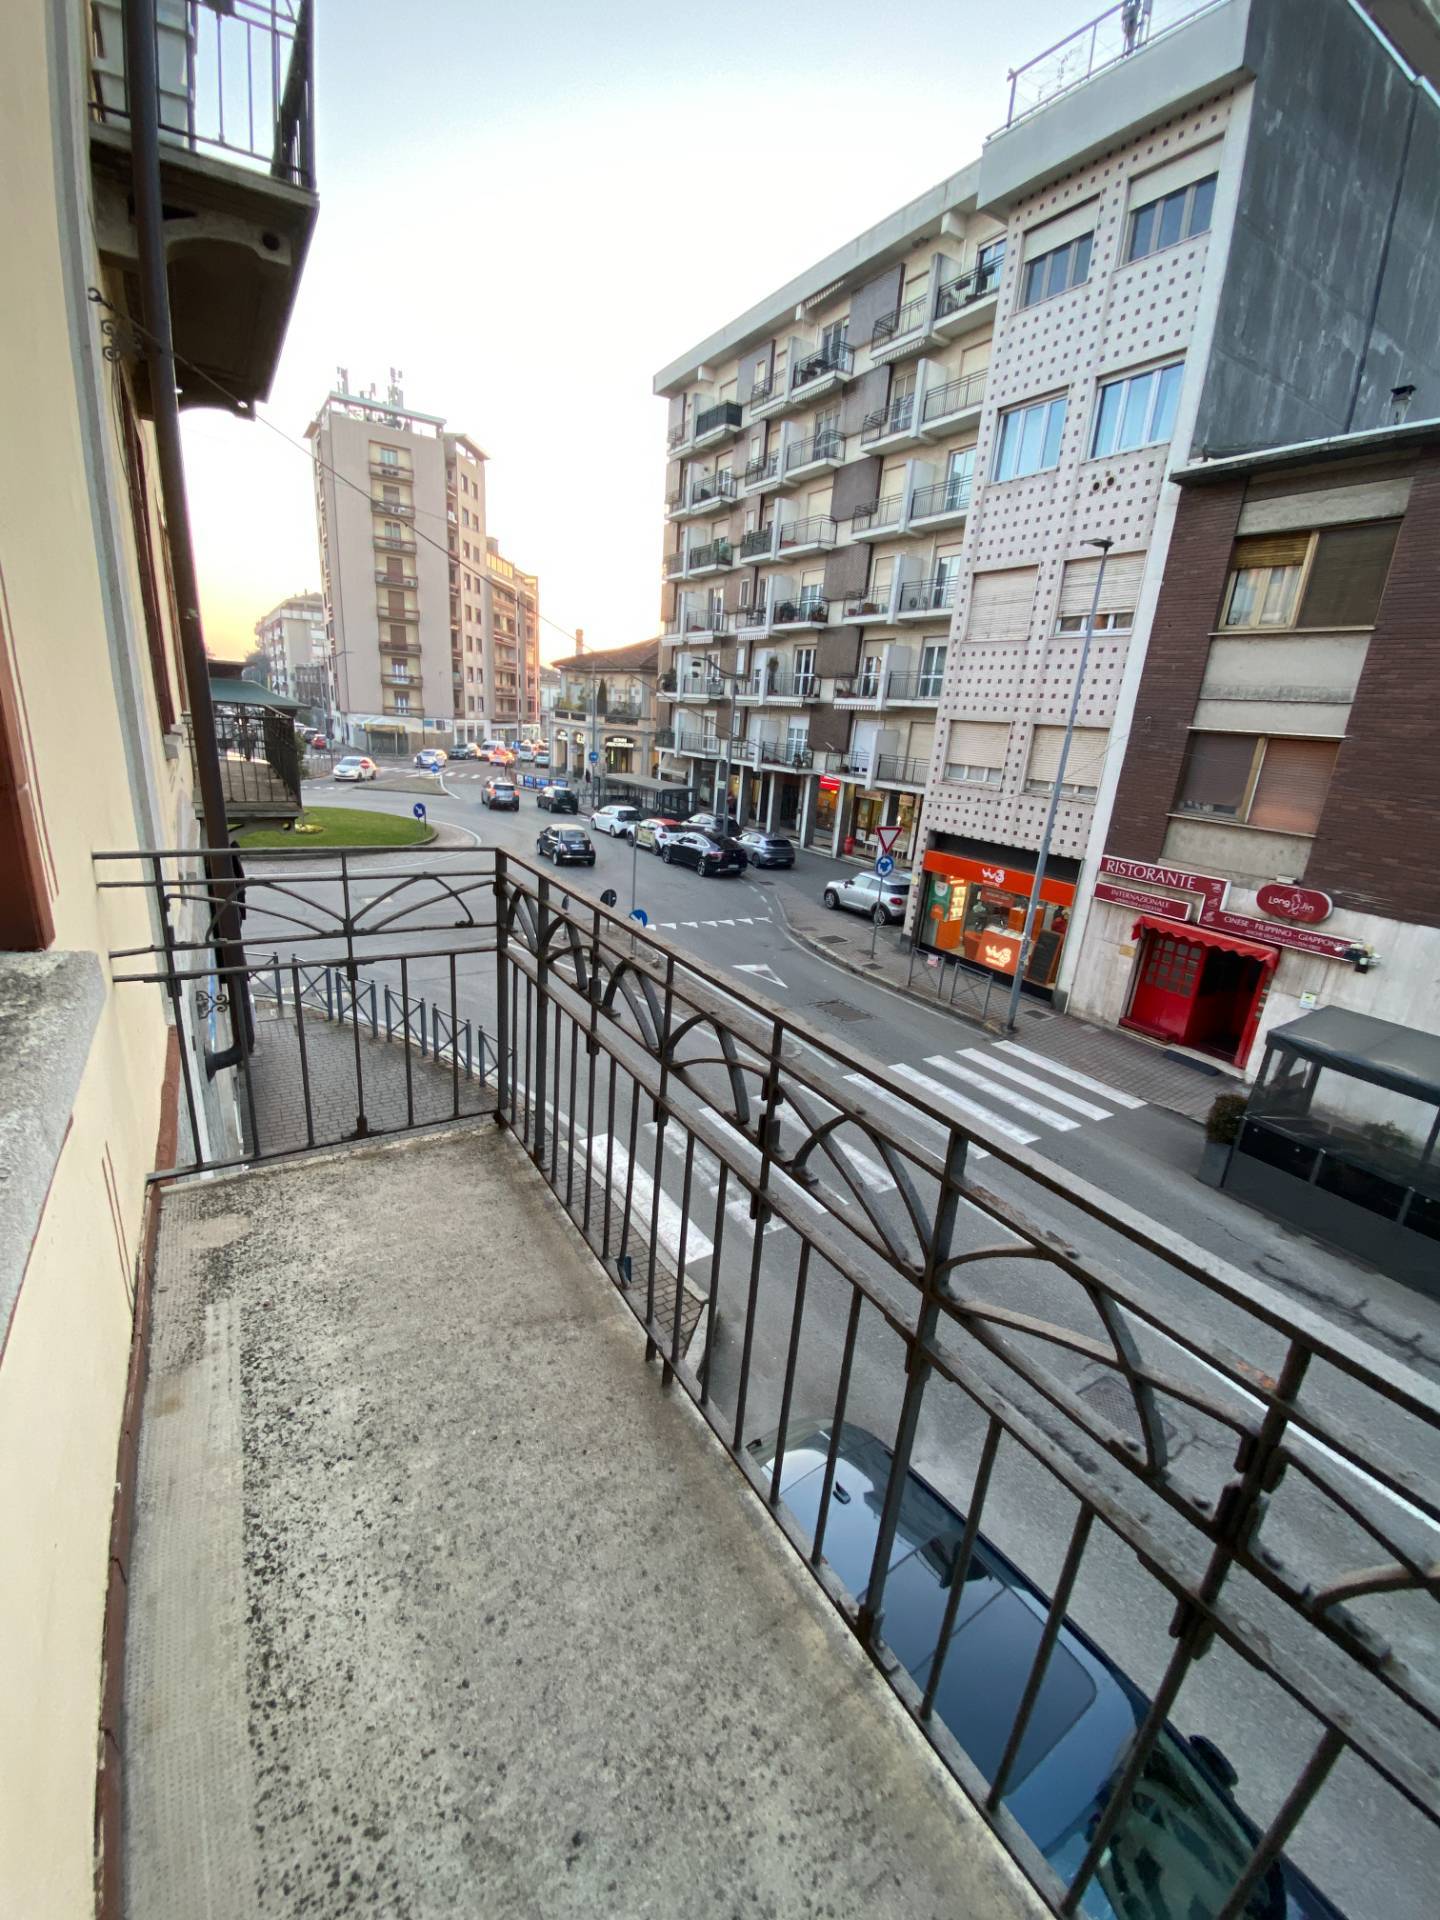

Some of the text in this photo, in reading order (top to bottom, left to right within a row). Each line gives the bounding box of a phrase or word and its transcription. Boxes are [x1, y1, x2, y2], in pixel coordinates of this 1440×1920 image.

[1106, 860, 1196, 889] RISTORANTE
[1111, 889, 1170, 908] INTERNAZIONALE
[1268, 896, 1291, 908] Long
[1224, 916, 1249, 928] CINESE
[1254, 923, 1292, 937] FILIPPINO
